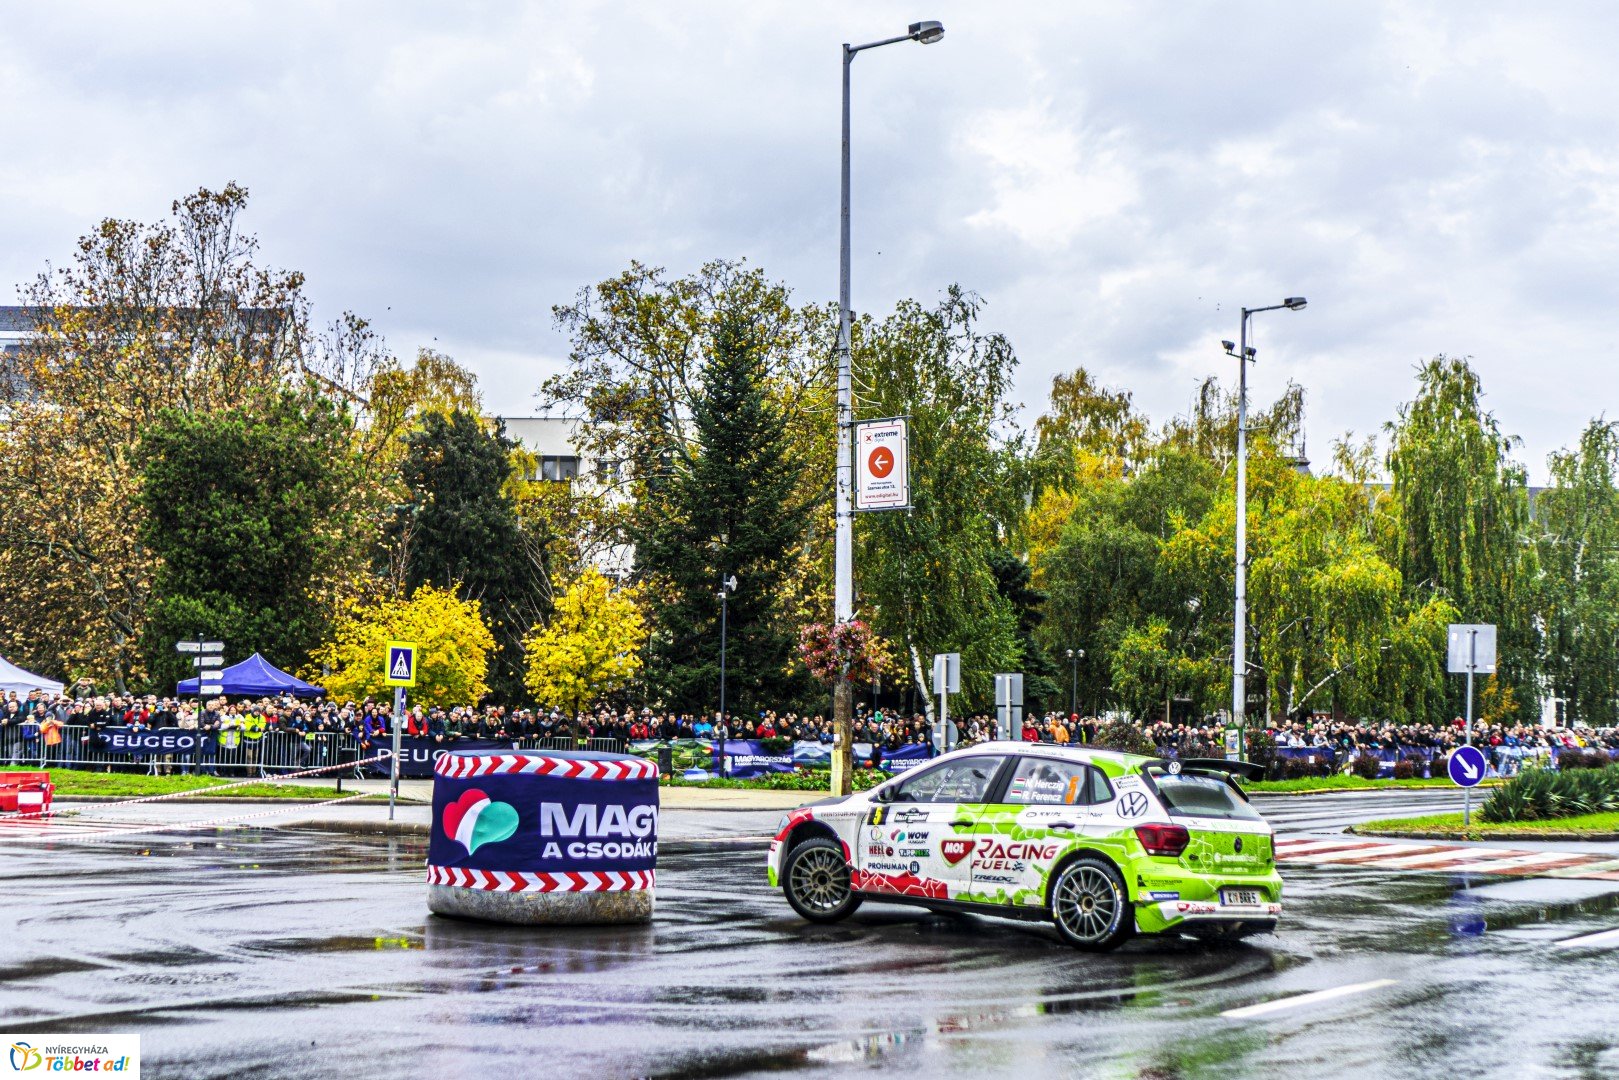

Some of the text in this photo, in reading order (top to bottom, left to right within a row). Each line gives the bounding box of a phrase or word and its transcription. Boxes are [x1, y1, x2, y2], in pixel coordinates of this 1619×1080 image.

[1034, 780, 1064, 791] Herczig
[1065, 775, 1080, 805] 5
[1030, 792, 1061, 802] Ferencz
[872, 806, 883, 825] 5
[542, 842, 563, 858] A
[567, 837, 651, 858] CSODÁK
[868, 845, 884, 855] HELL
[944, 842, 965, 854] MOL
[977, 838, 1059, 860] RACING
[868, 862, 908, 870] PROHUMAN
[971, 860, 1011, 870] FUEL
